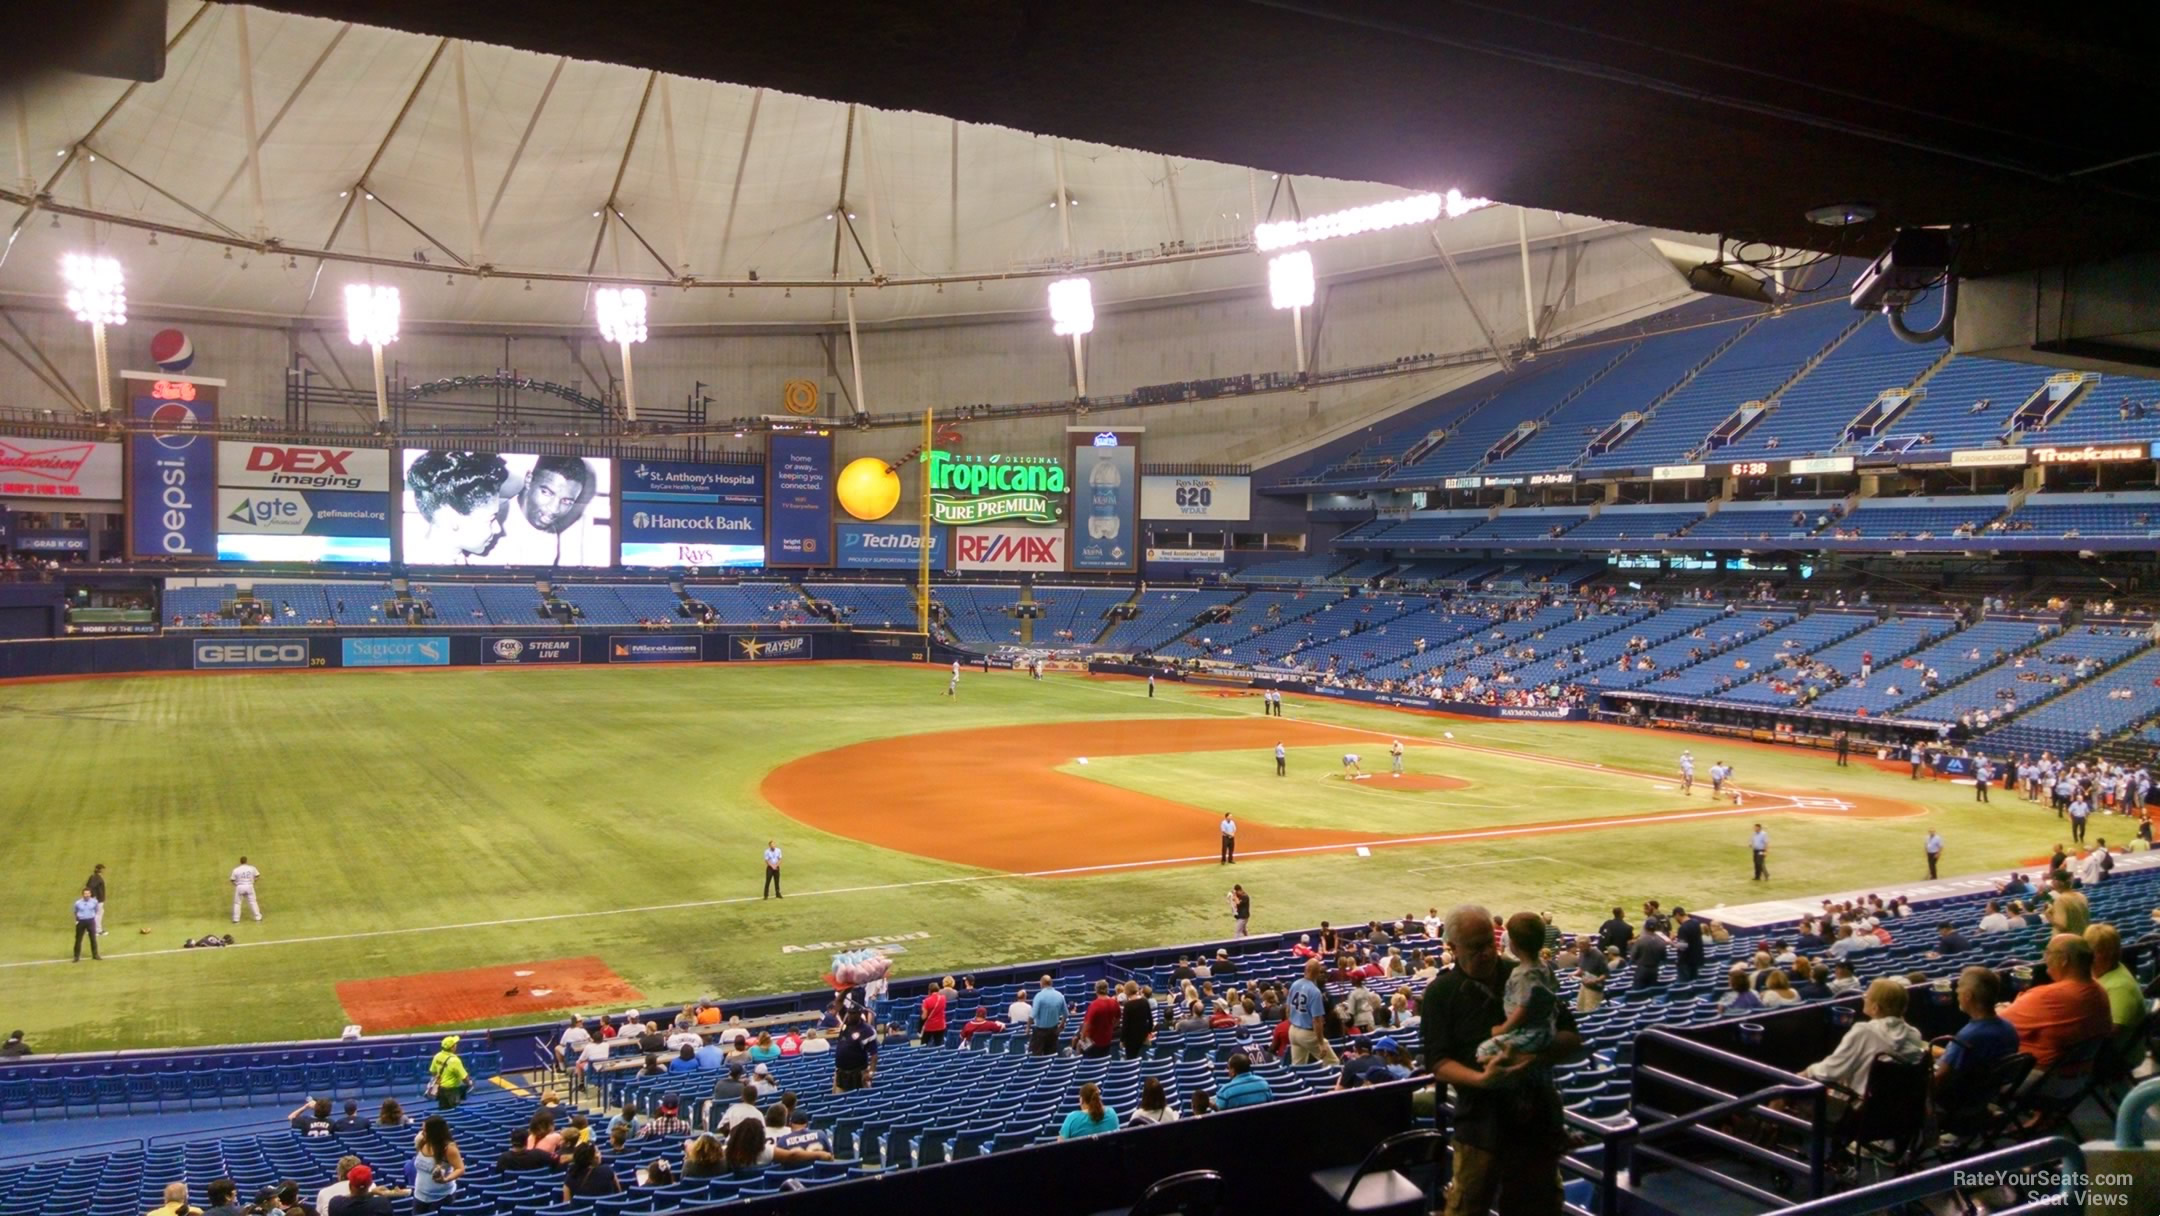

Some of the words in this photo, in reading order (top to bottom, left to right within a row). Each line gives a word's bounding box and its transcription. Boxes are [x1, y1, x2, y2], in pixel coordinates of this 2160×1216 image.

[245, 446, 354, 475] DEX
[790, 453, 812, 462] home
[1005, 456, 1059, 464] ORIGINAL
[2032, 447, 2142, 462] Tropicana
[920, 450, 1065, 495] Tropicana
[1731, 463, 1767, 476] 6:38
[271, 472, 362, 488] imaging
[650, 471, 664, 481] St.
[665, 472, 714, 485] Anthony's
[715, 474, 755, 486] Hospital
[778, 472, 809, 482] keeping
[809, 474, 823, 483] you
[780, 482, 821, 490] connected.
[1176, 487, 1211, 507] 620
[157, 460, 192, 553] pepsi
[256, 498, 298, 520] gte
[935, 502, 975, 519] PURE
[977, 499, 1046, 518] PREMIUM
[316, 509, 386, 521] gtefinancial.org
[651, 514, 715, 529] Hancock
[716, 515, 753, 531] Bank
[34, 540, 56, 548] GRAB
[68, 540, 83, 548] GO!
[958, 534, 1058, 563] RE/MAX
[353, 640, 413, 659] Sagicor
[529, 641, 570, 650] STREAM
[198, 644, 305, 663] GEICO
[310, 657, 326, 665] 370
[539, 650, 559, 658] LIVE
[1501, 709, 1539, 717] RAYMOND
[1291, 991, 1308, 1013] 42
